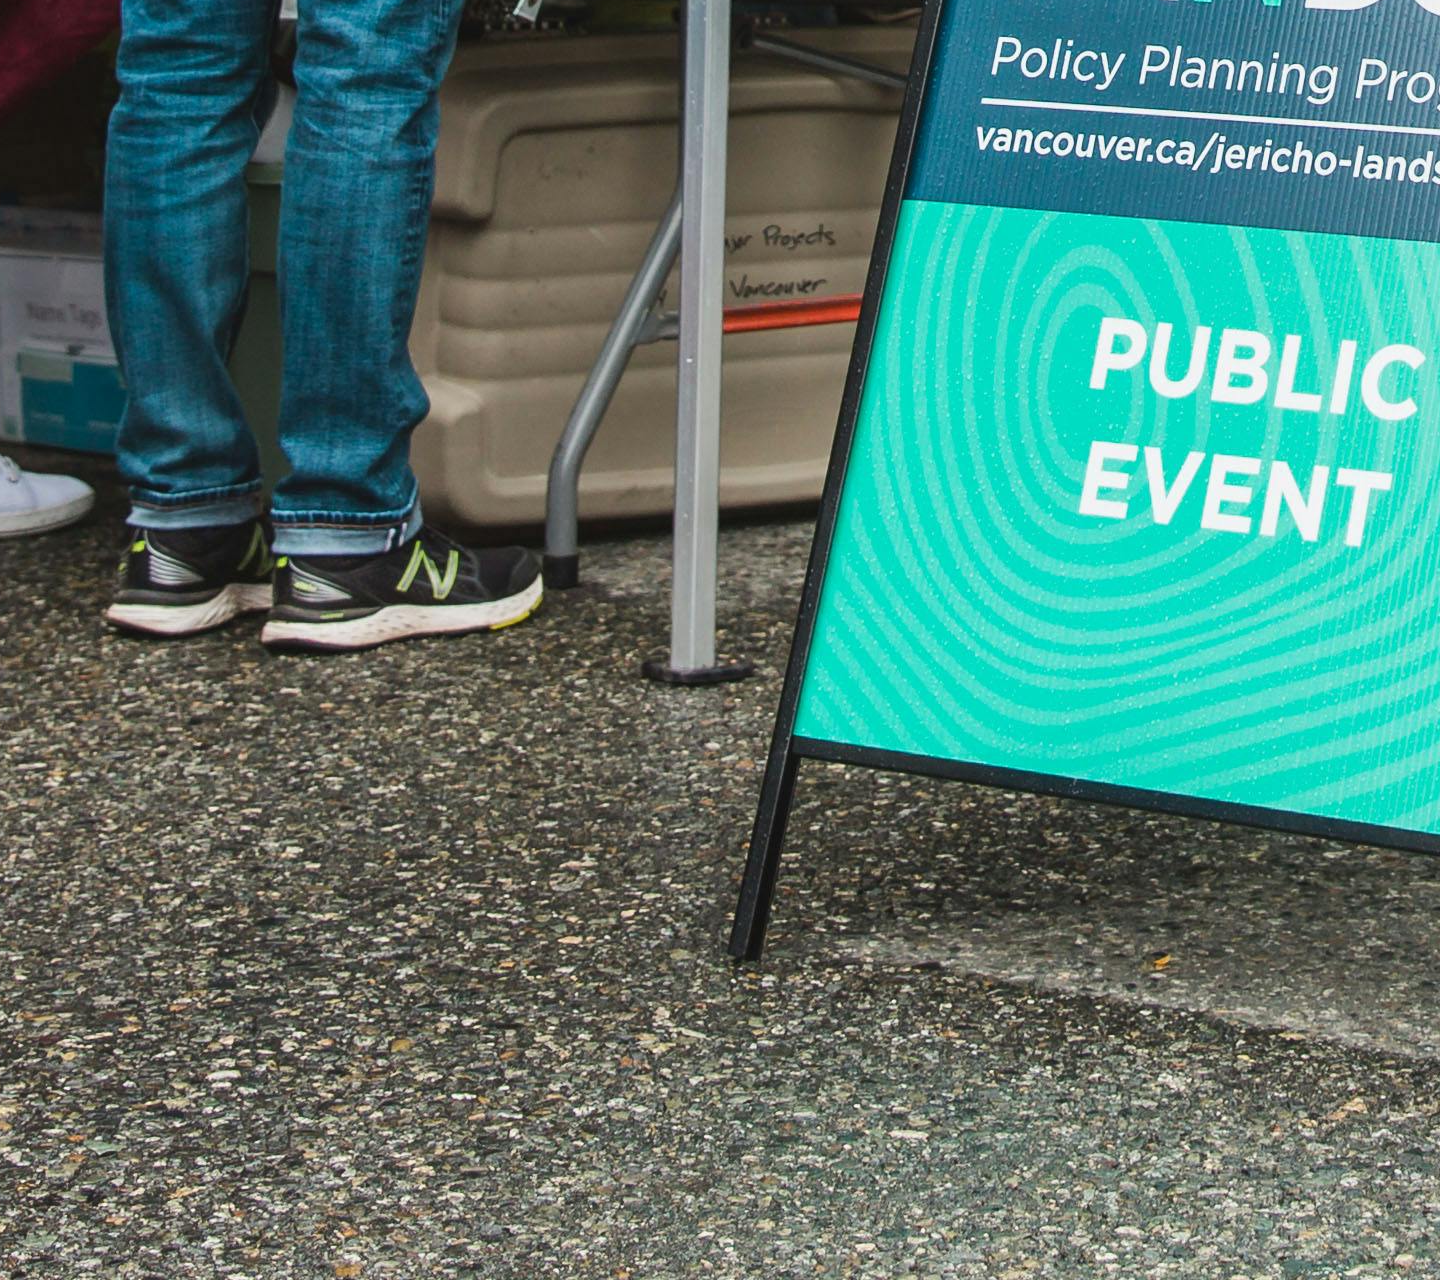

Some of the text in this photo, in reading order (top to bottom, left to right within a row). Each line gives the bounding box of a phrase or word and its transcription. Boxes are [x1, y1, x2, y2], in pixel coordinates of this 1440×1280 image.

[991, 36, 1125, 90] Policy
[1139, 44, 1339, 105] Planning
[763, 223, 837, 251] Projects
[728, 273, 827, 299] Vancouver
[1088, 316, 1426, 423] PUBLIC
[1077, 441, 1393, 548] EVENT
